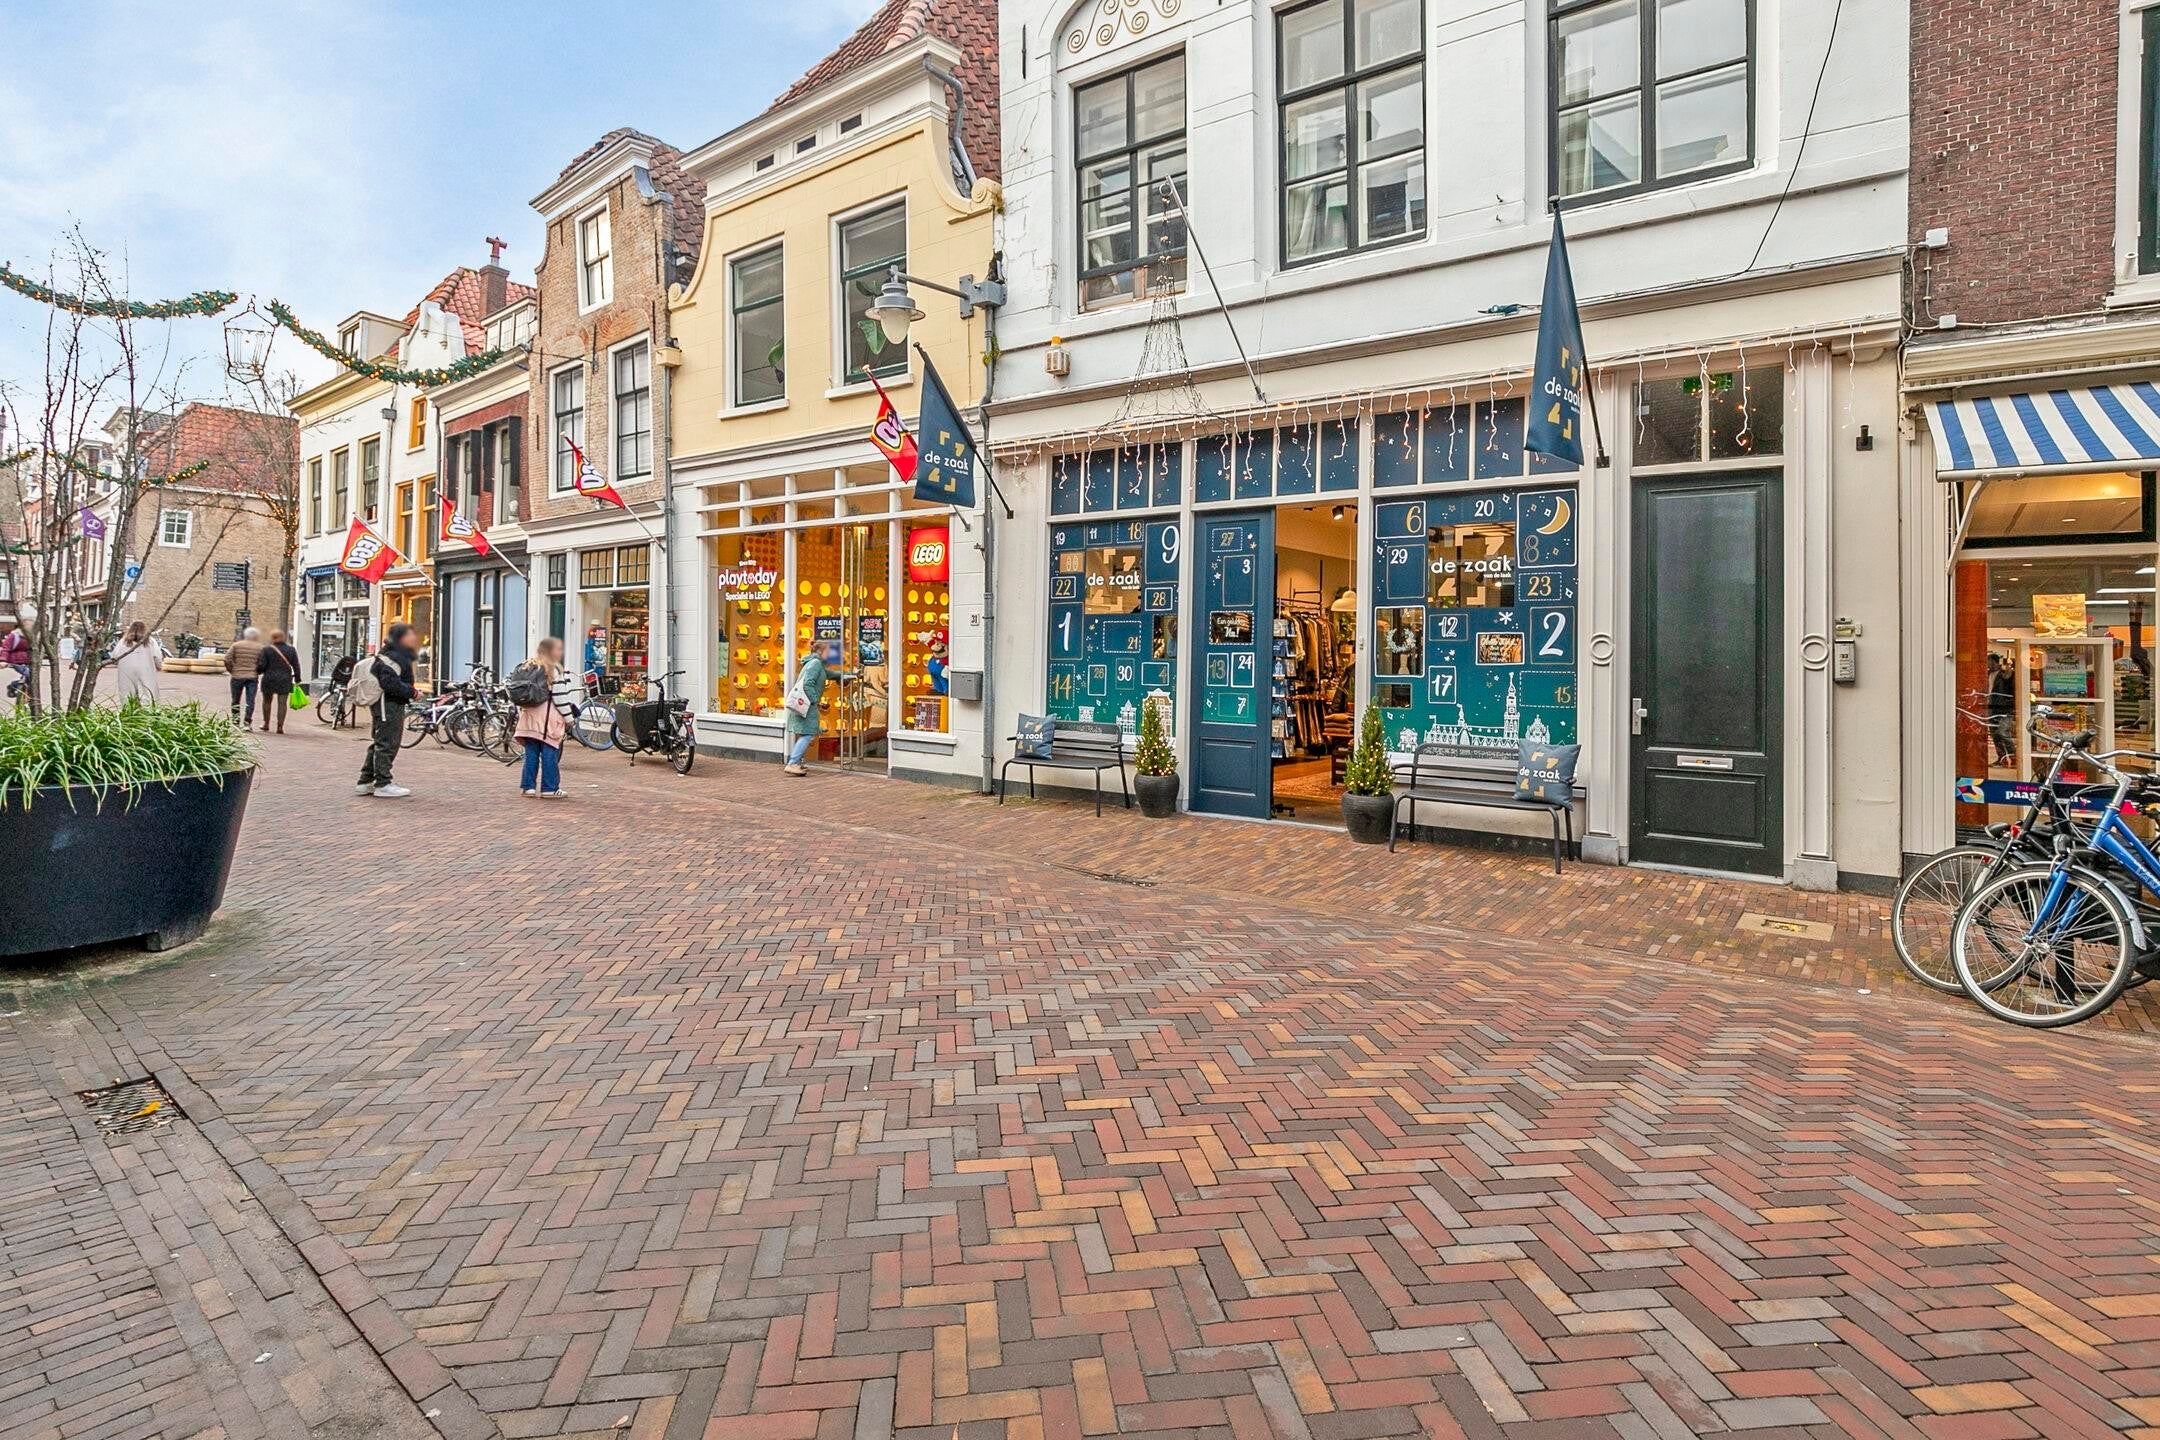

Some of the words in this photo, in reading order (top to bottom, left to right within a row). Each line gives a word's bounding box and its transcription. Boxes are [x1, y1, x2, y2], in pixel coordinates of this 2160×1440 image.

[1544, 376, 1561, 396] de
[924, 451, 941, 464] de
[944, 458, 969, 470] zaak
[1474, 499, 1495, 517] 20
[1406, 505, 1422, 533] 6
[1055, 532, 1066, 545] 19
[1089, 527, 1098, 540] 11
[1128, 522, 1142, 540] 18
[1220, 532, 1235, 547] 27
[912, 543, 945, 565] LEGO
[1162, 525, 1180, 564] 9
[1523, 534, 1540, 563] 8
[1390, 548, 1408, 564] 29
[1430, 557, 1456, 574] de
[1464, 555, 1512, 573] zaak
[1242, 559, 1251, 574] 3
[718, 566, 778, 590] playtoday
[1056, 579, 1072, 596] 22
[1088, 573, 1104, 586] de
[1109, 570, 1141, 586] zaak
[1527, 575, 1552, 596] 23
[1152, 592, 1166, 606] 28
[1058, 611, 1071, 651] 1
[1438, 616, 1459, 638] 12
[1538, 612, 1566, 656] 2
[1127, 636, 1139, 650] 21
[1210, 659, 1226, 679] 13
[1238, 655, 1252, 670] 24
[1117, 665, 1132, 681] 30
[1052, 673, 1072, 700] 14
[1432, 674, 1453, 697] 17
[1554, 686, 1572, 704] 15
[1237, 696, 1246, 715] 7
[1519, 766, 1530, 776] de
[1533, 769, 1561, 780] zaak
